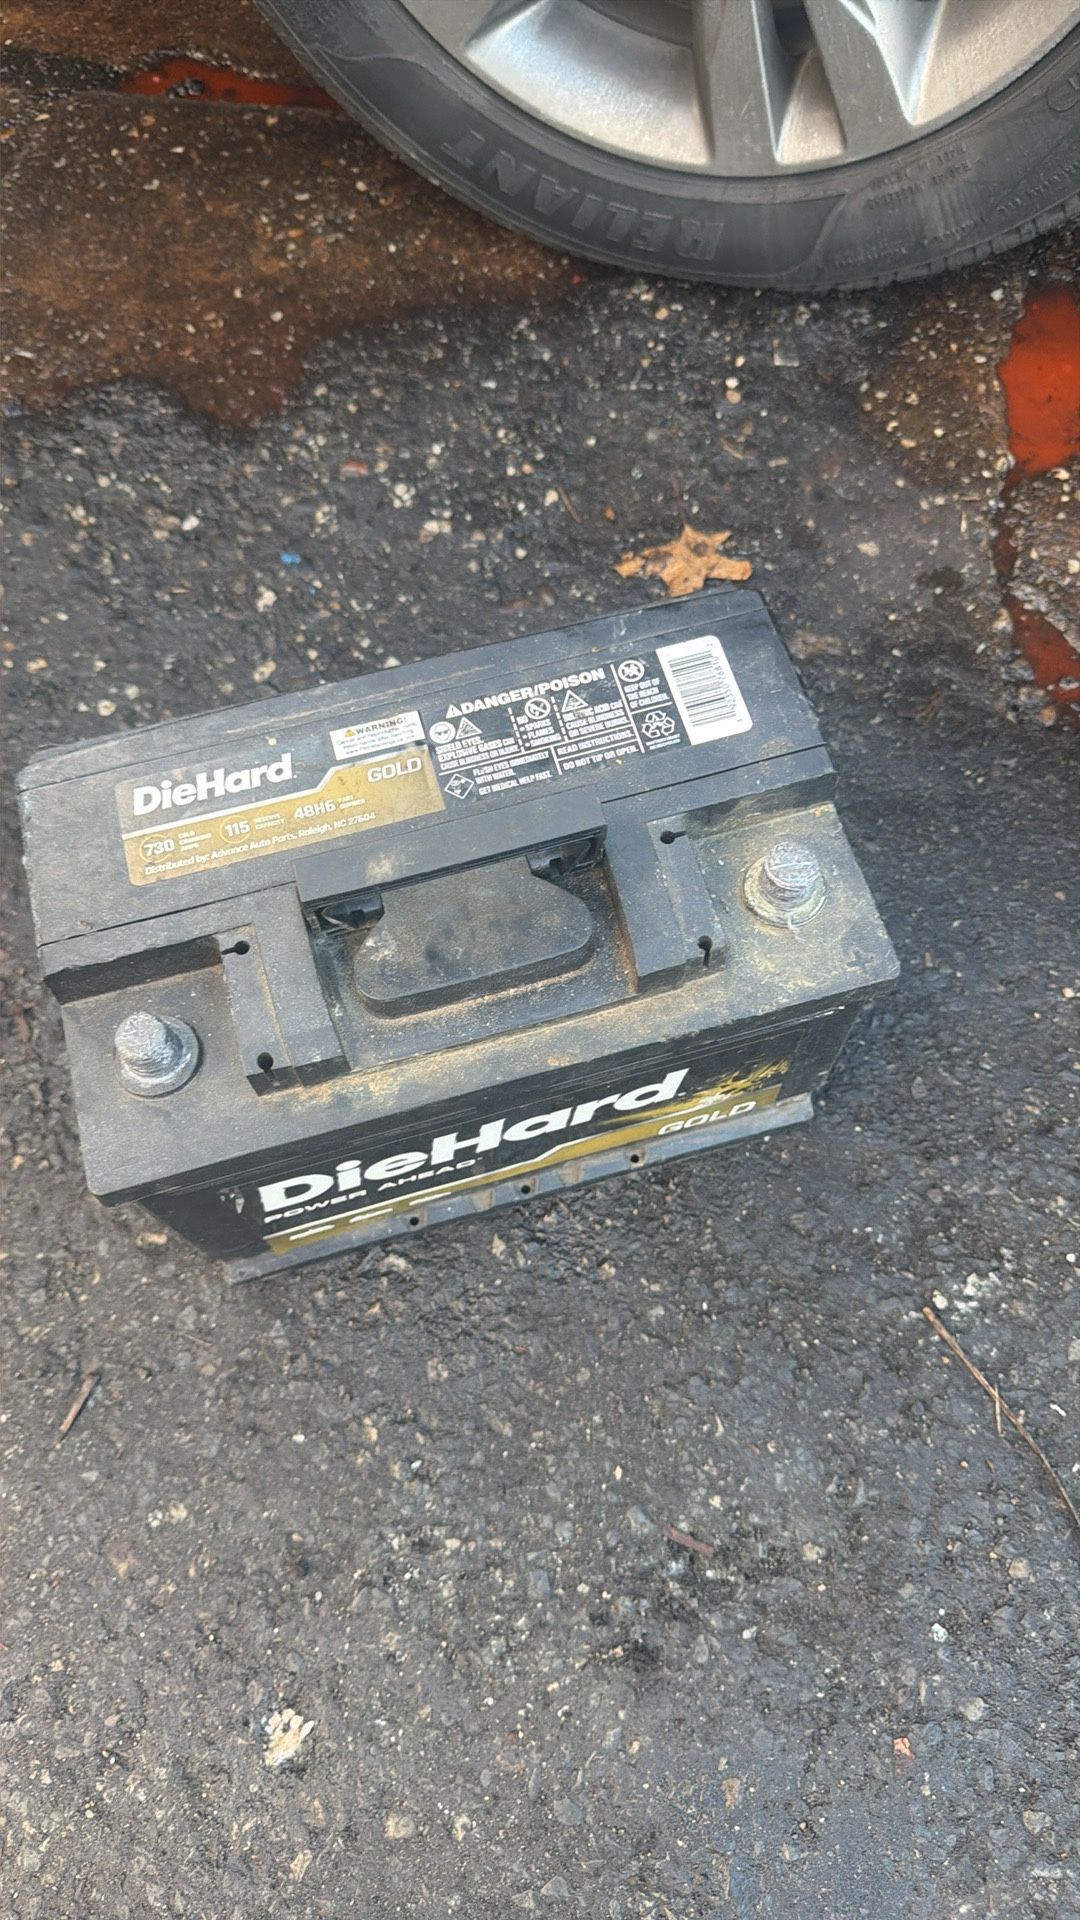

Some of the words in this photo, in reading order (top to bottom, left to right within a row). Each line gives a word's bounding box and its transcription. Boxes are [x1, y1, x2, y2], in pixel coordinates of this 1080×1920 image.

[441, 130, 724, 261] RELIANT
[461, 669, 605, 713] DANGER/POISON
[594, 703, 609, 713] ACID
[355, 718, 407, 733] WARNING:
[525, 719, 551, 730] SPARKS
[528, 727, 554, 738] FLAMES
[569, 729, 579, 737] OR
[579, 723, 604, 734] SEVERE
[436, 742, 461, 754] SHIELD
[462, 737, 483, 747] EYES.
[438, 746, 477, 761] EXPLOSIVE
[478, 740, 502, 751] GASES
[557, 744, 577, 754] READ
[579, 730, 633, 749] INSTRUCTIONS.
[494, 761, 509, 771] EYES
[563, 761, 575, 770] DO
[575, 757, 590, 766] NOT
[590, 753, 603, 762] TIP
[604, 751, 615, 759] OR
[616, 745, 638, 756] OPEN.
[367, 758, 421, 782] GOLD
[475, 775, 492, 784] WITH
[133, 753, 292, 815] DieHard
[479, 786, 490, 795] GET
[491, 780, 518, 791] MEDICAL
[519, 775, 534, 784] HELP
[294, 799, 335, 819] 48H6
[225, 820, 249, 836] 115
[144, 839, 174, 856] 730
[145, 856, 194, 874] Distributed
[195, 854, 209, 863] by:
[211, 845, 247, 858] Advance
[250, 839, 270, 849] Auto
[272, 833, 297, 844] Parts,
[298, 824, 332, 837] Raleigh,
[333, 819, 346, 828] NC
[657, 1101, 757, 1135] GOLD
[258, 1068, 690, 1213] DieHard
[263, 1189, 368, 1224] POWER
[377, 1160, 475, 1191] AHEAD
